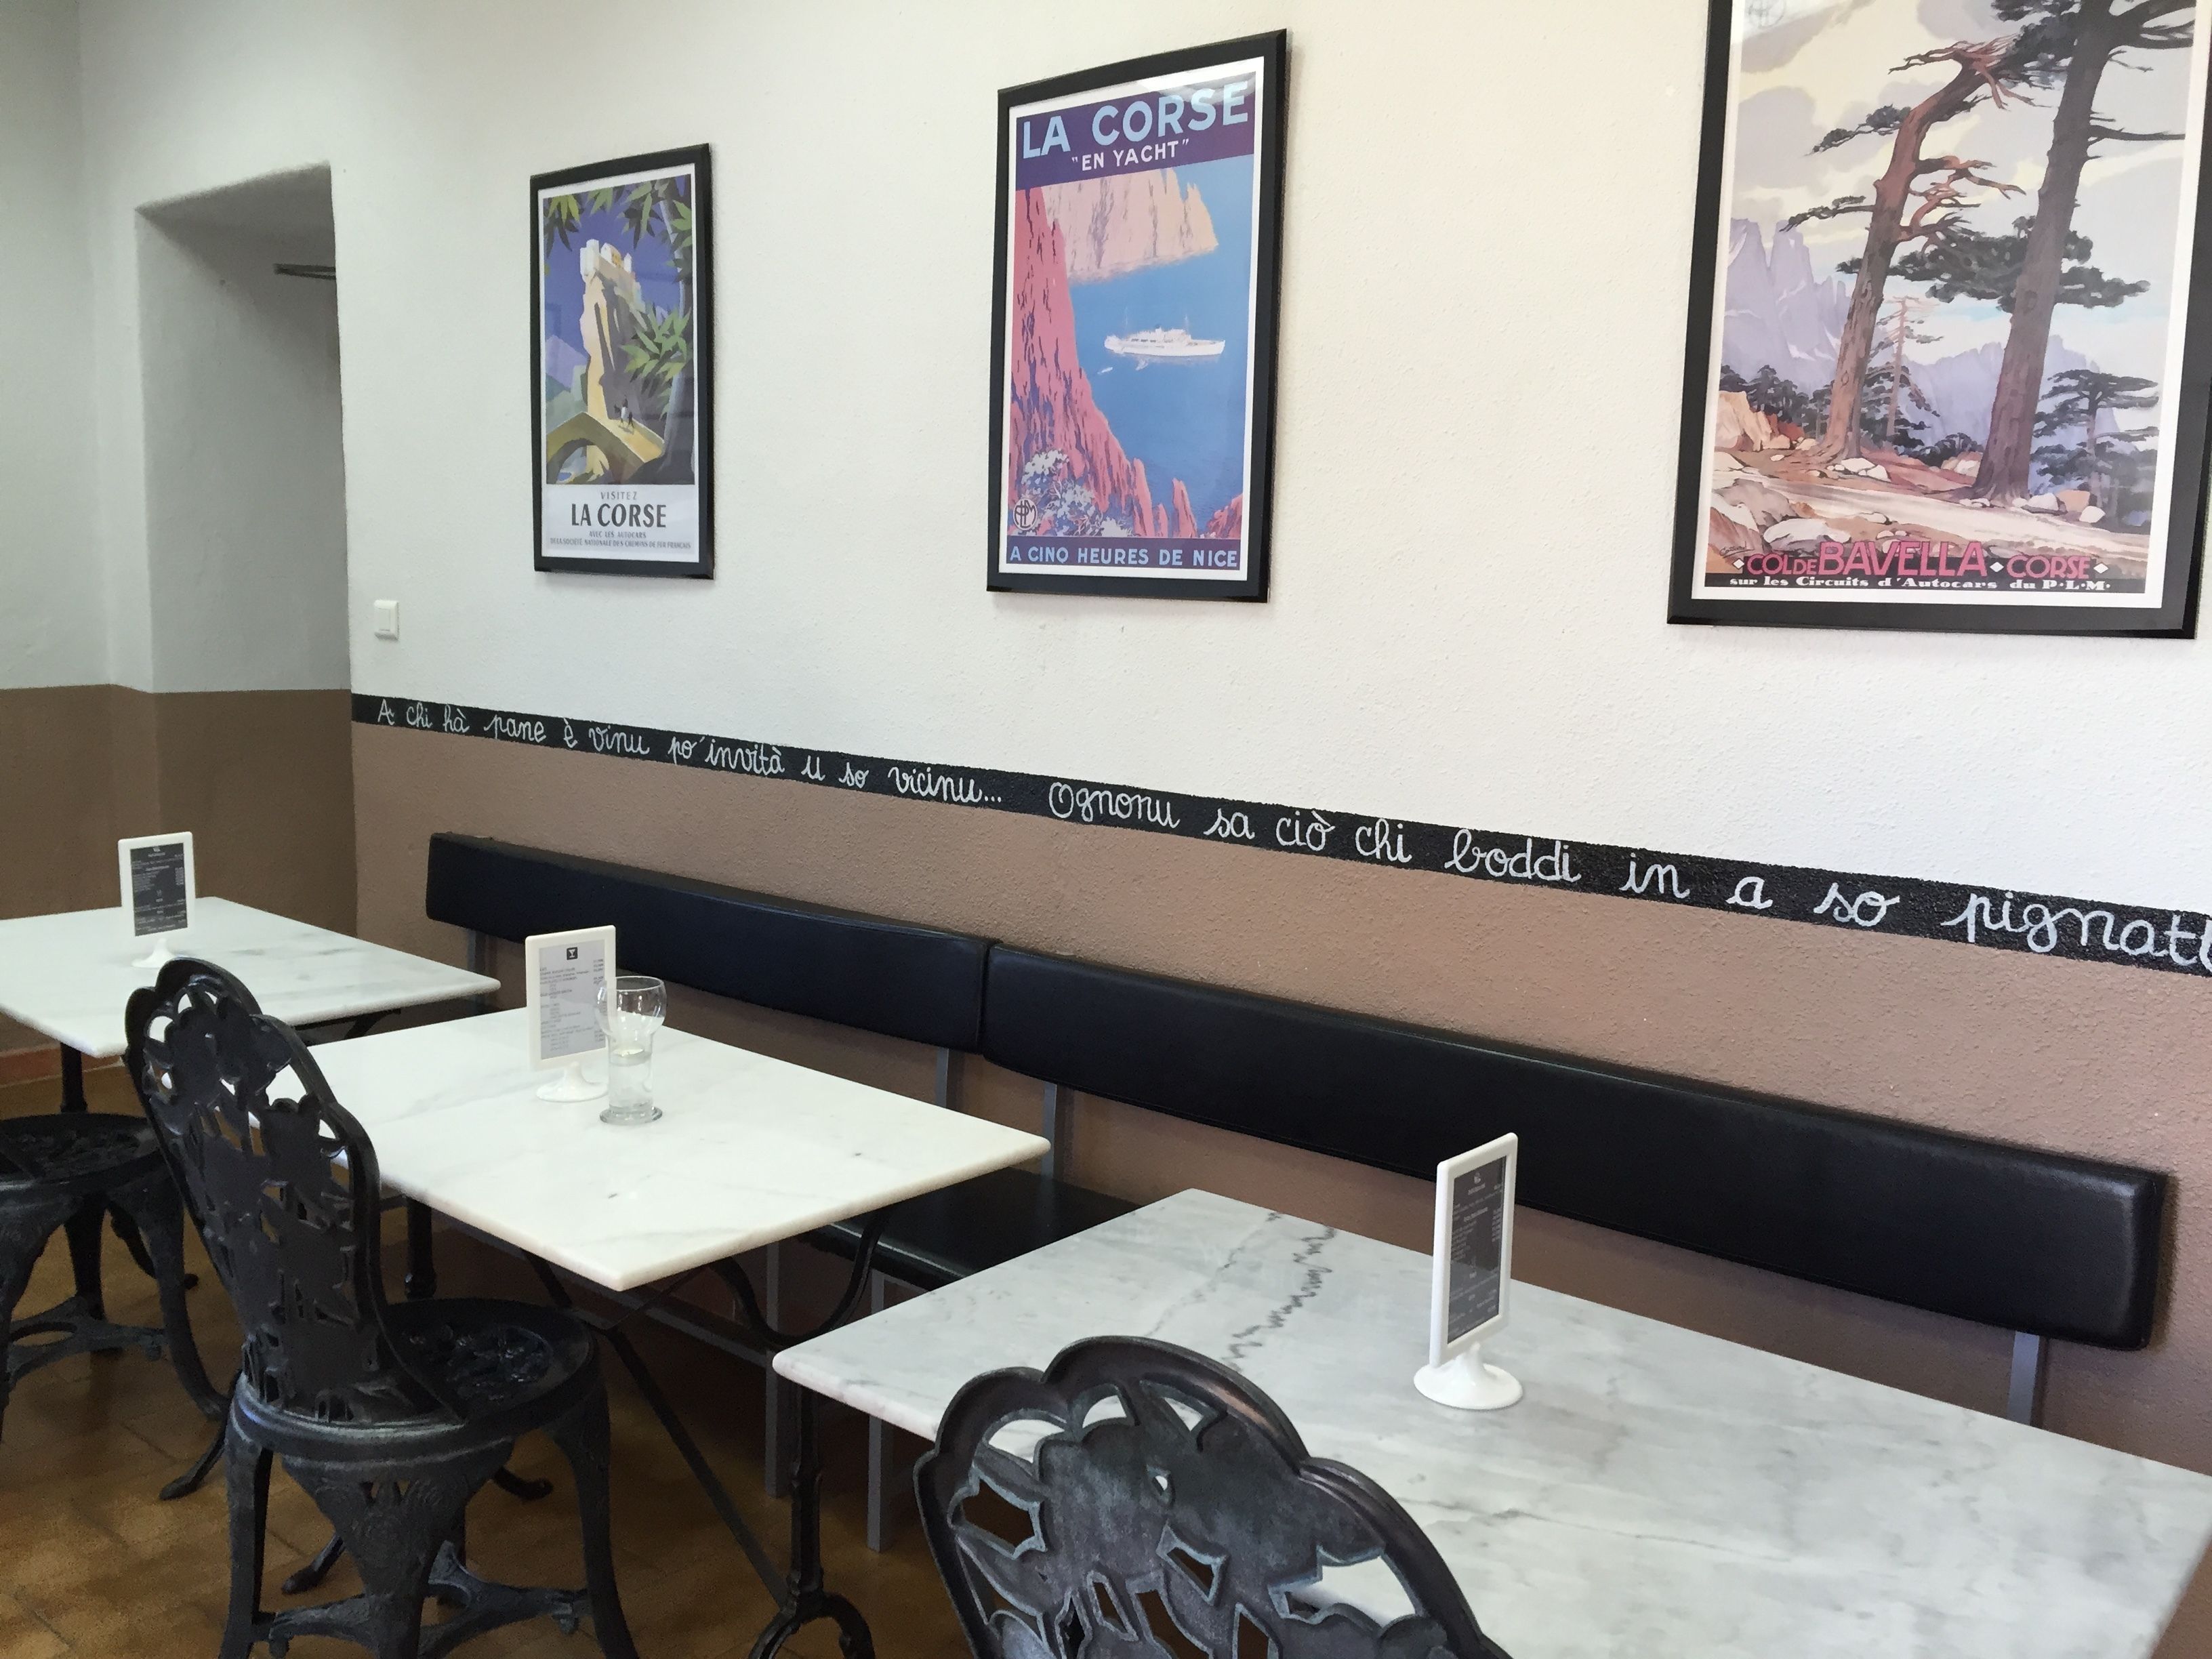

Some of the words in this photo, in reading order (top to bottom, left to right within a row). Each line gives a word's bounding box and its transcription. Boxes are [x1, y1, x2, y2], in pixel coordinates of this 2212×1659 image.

[1023, 115, 1071, 159] LA
[1092, 80, 1248, 146] CORSE
[600, 491, 637, 500] VISITEZ
[571, 503, 592, 526] LA
[597, 503, 666, 528] CORSE
[1010, 546, 1021, 562] A
[1078, 548, 1149, 565] HEURES
[1159, 549, 1183, 566] DE
[1193, 550, 1237, 567] NICE
[1818, 541, 1988, 576] BAVELLA
[2006, 554, 2091, 579] CORSE
[1763, 576, 1788, 586] les
[1796, 576, 1868, 587] Circuits
[2009, 579, 2036, 589] du
[377, 699, 395, 726] A
[406, 701, 432, 728] chi
[443, 703, 470, 733] hà
[483, 714, 546, 743] pane
[563, 717, 578, 748] è
[589, 724, 650, 755] vinu
[801, 755, 825, 781] u
[838, 761, 869, 788] so
[888, 766, 1002, 803] vicinu...
[1048, 781, 1180, 829] Ognonu
[1204, 808, 1255, 840] sa
[1276, 810, 1335, 851] ciò
[1355, 818, 1412, 863] chi
[1444, 828, 1582, 882] boddi
[1619, 853, 1690, 899] in
[1726, 876, 1773, 909] a
[1814, 882, 1900, 927] so
